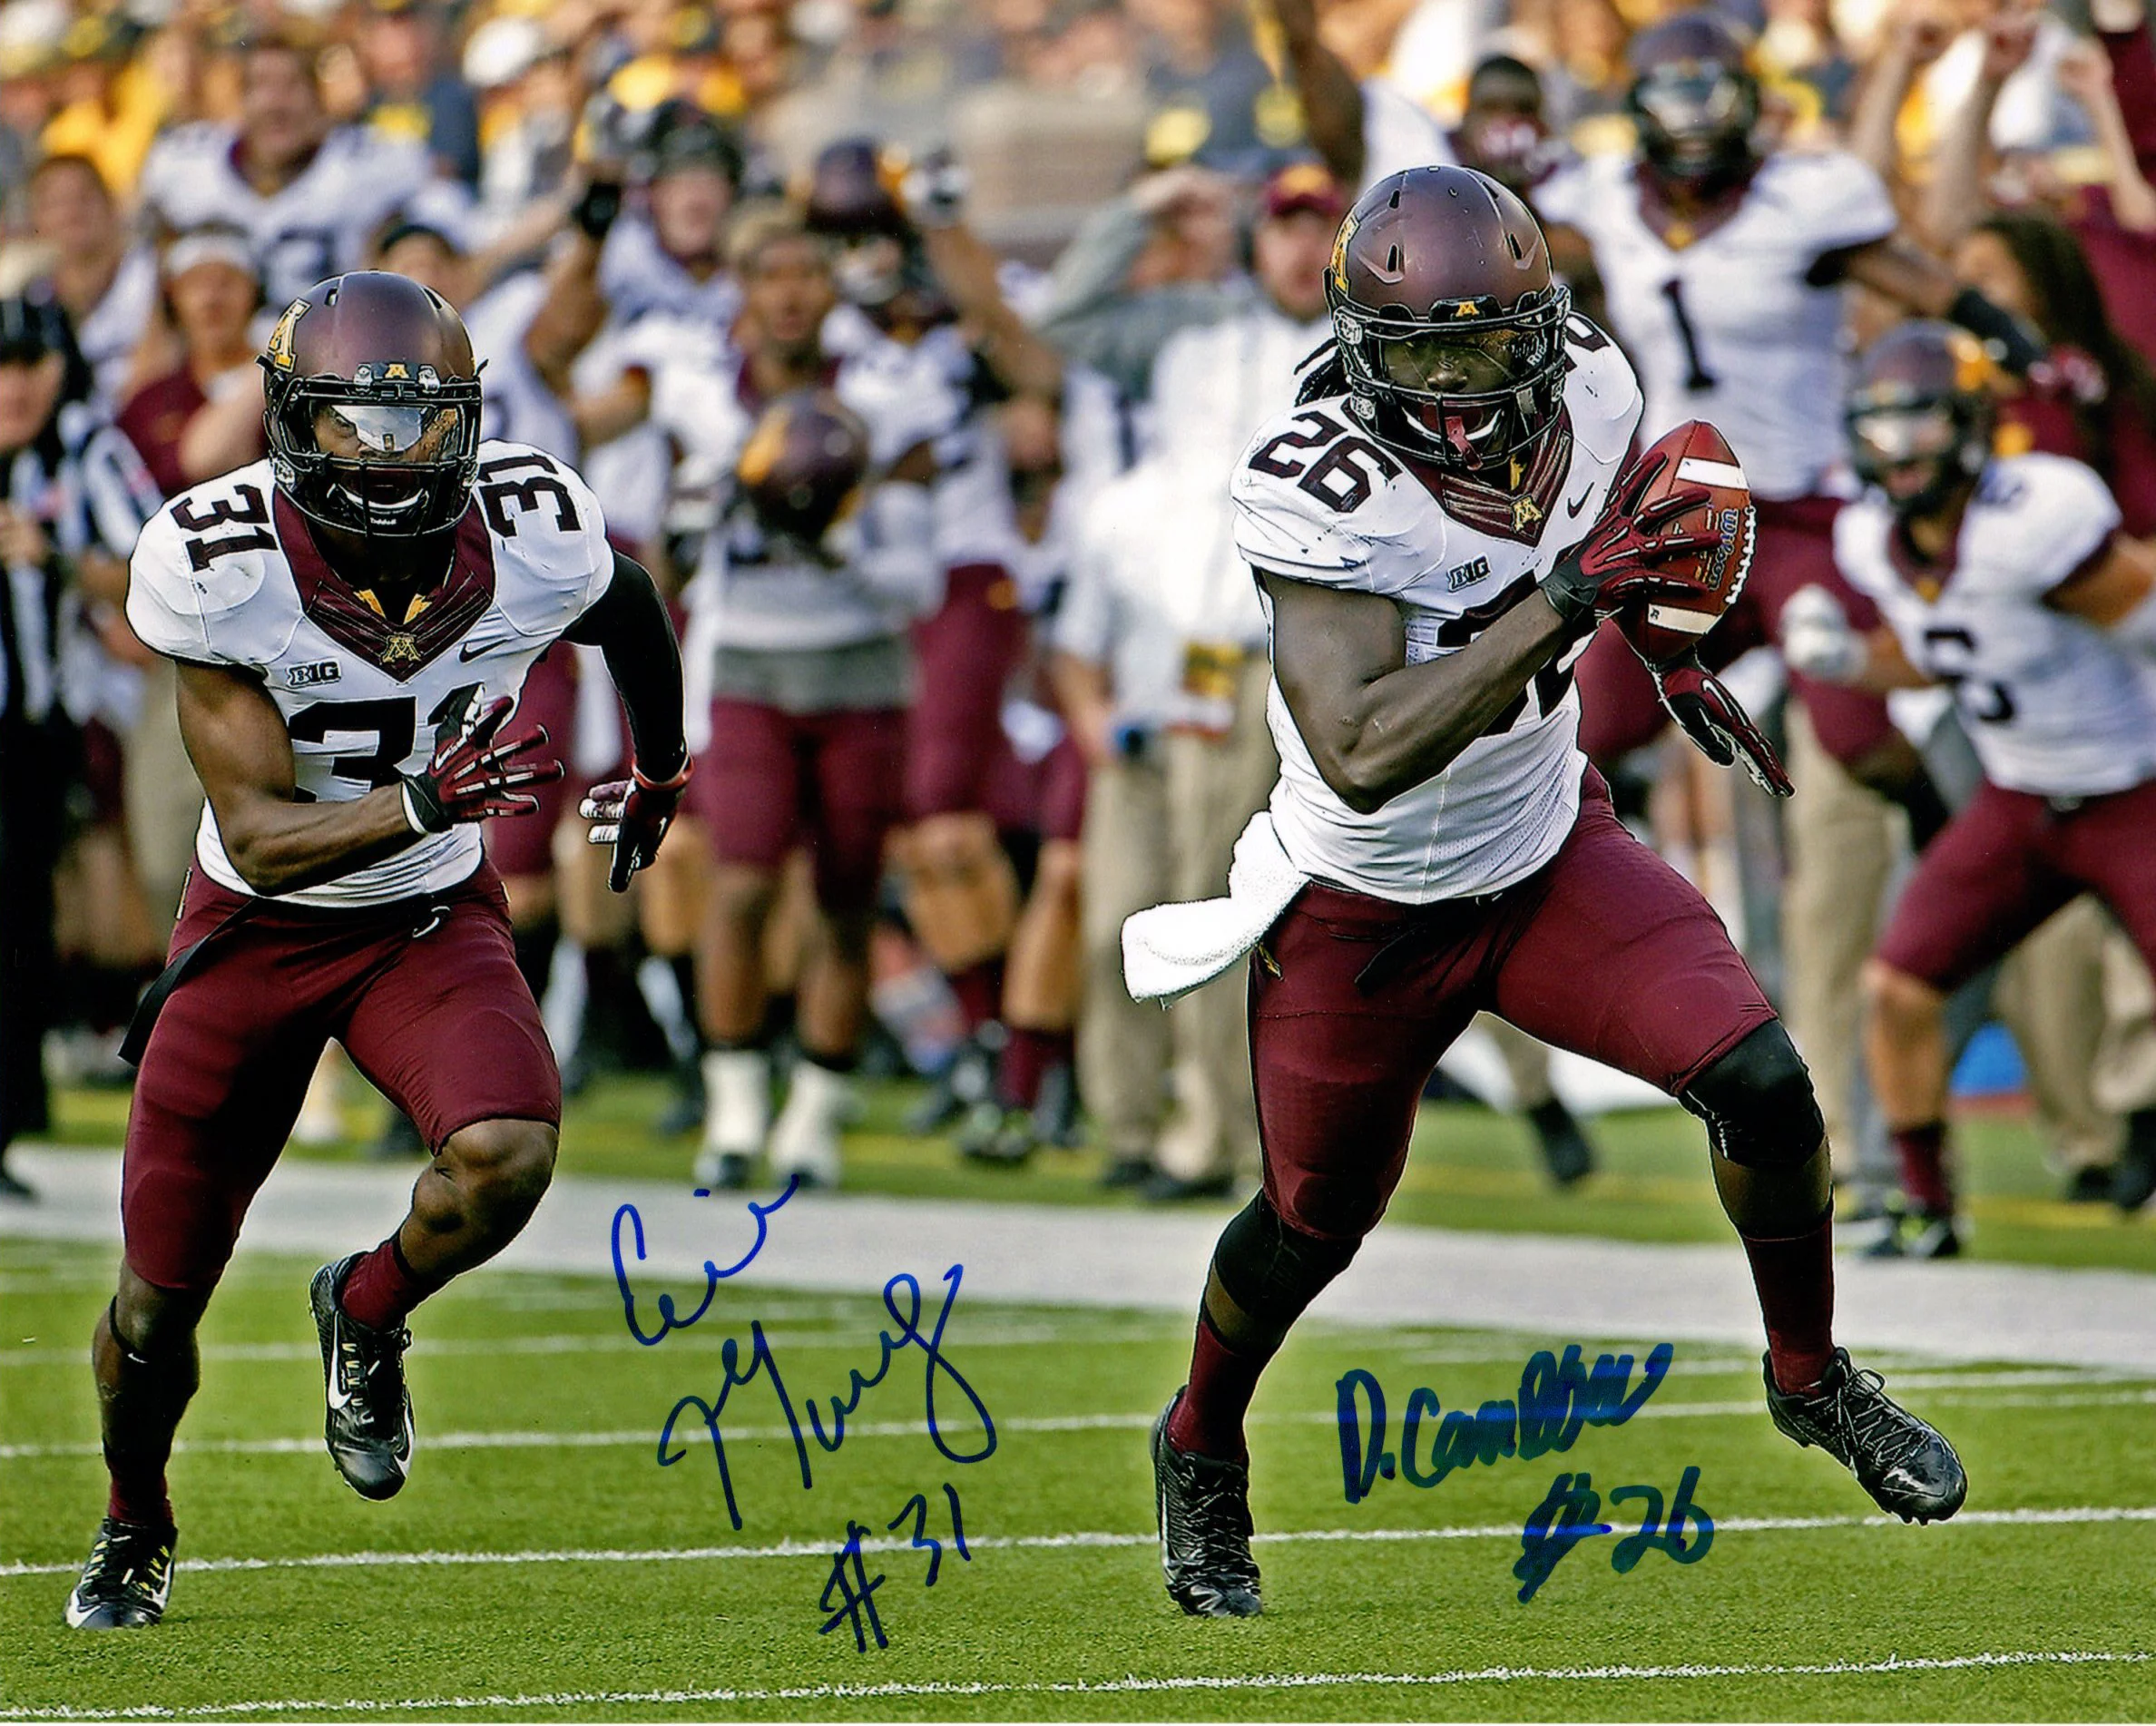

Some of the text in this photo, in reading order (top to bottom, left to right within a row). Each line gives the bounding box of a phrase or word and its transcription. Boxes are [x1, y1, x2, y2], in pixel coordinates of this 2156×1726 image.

[1662, 276, 1717, 390] 1
[479, 454, 583, 537] 31
[1248, 410, 1403, 514] 26
[169, 483, 278, 573] 31
